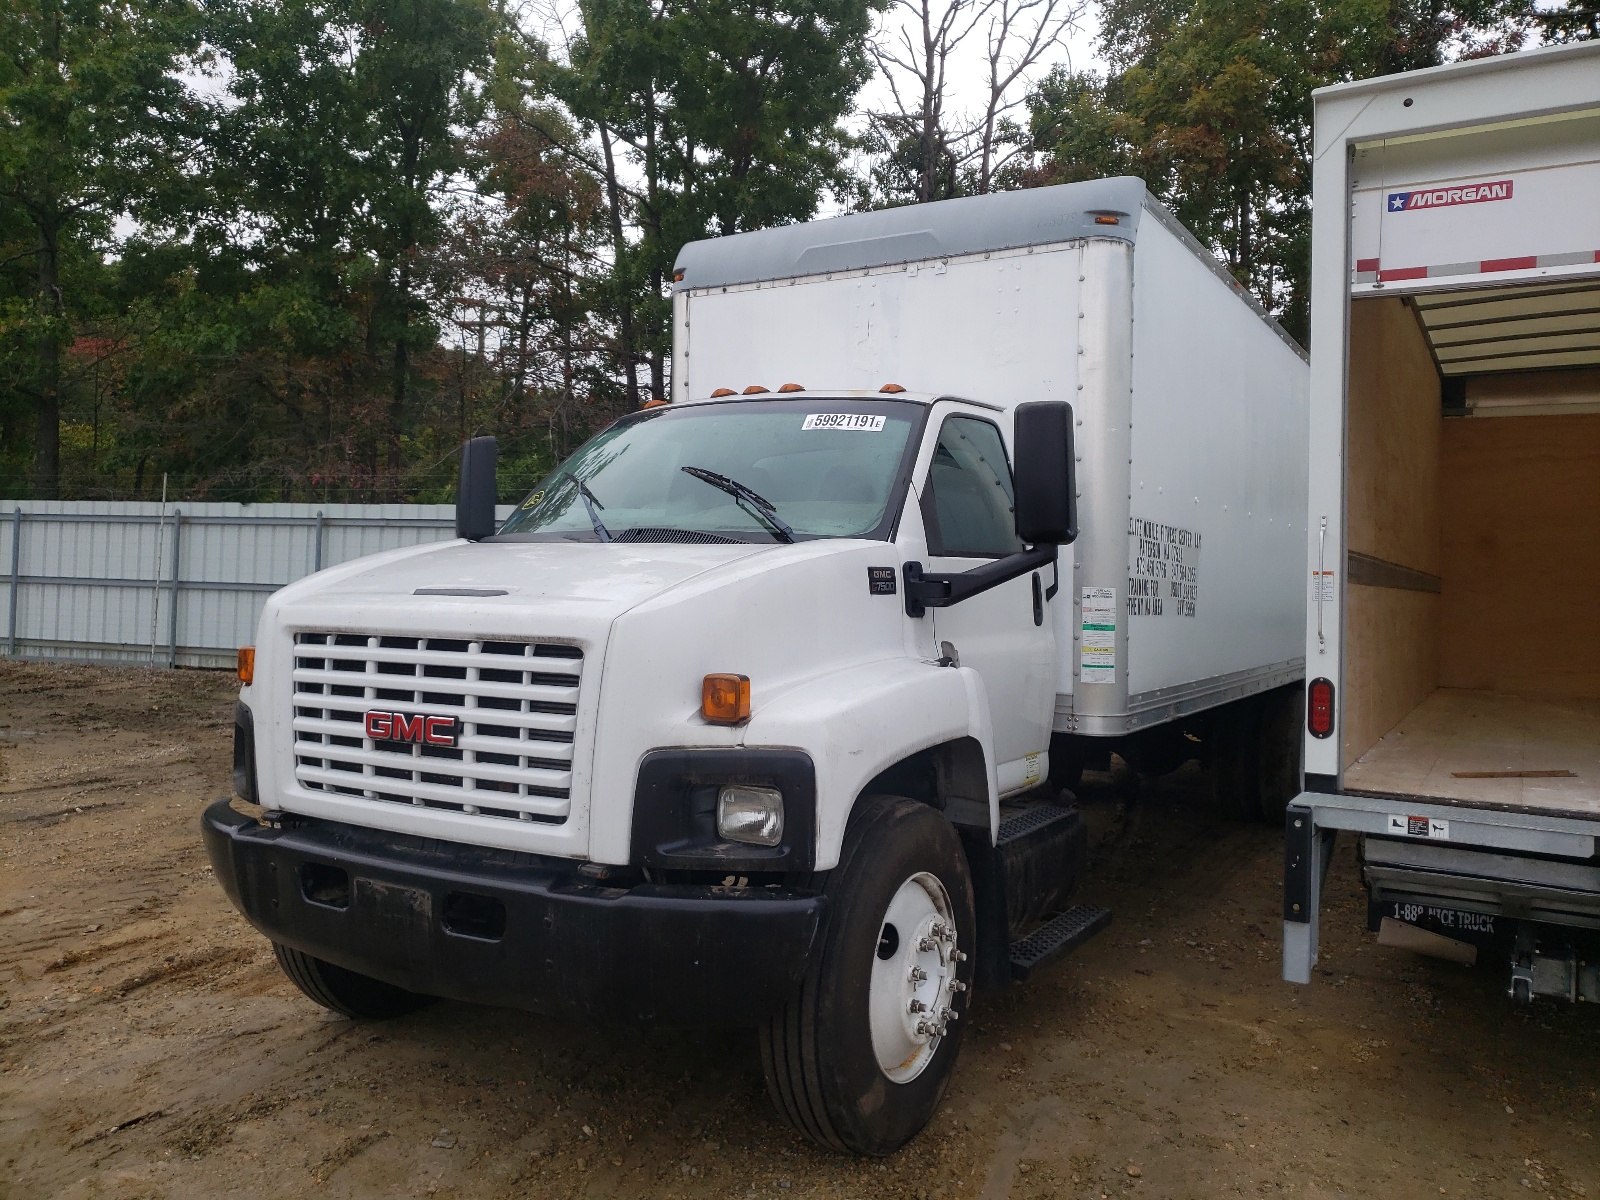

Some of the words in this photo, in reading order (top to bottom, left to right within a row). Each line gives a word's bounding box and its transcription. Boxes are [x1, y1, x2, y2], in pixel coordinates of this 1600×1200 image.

[1410, 183, 1507, 207] MORGAN
[814, 414, 876, 427] 59921191
[366, 711, 455, 745] GMC
[1457, 911, 1494, 933] TRUCK
